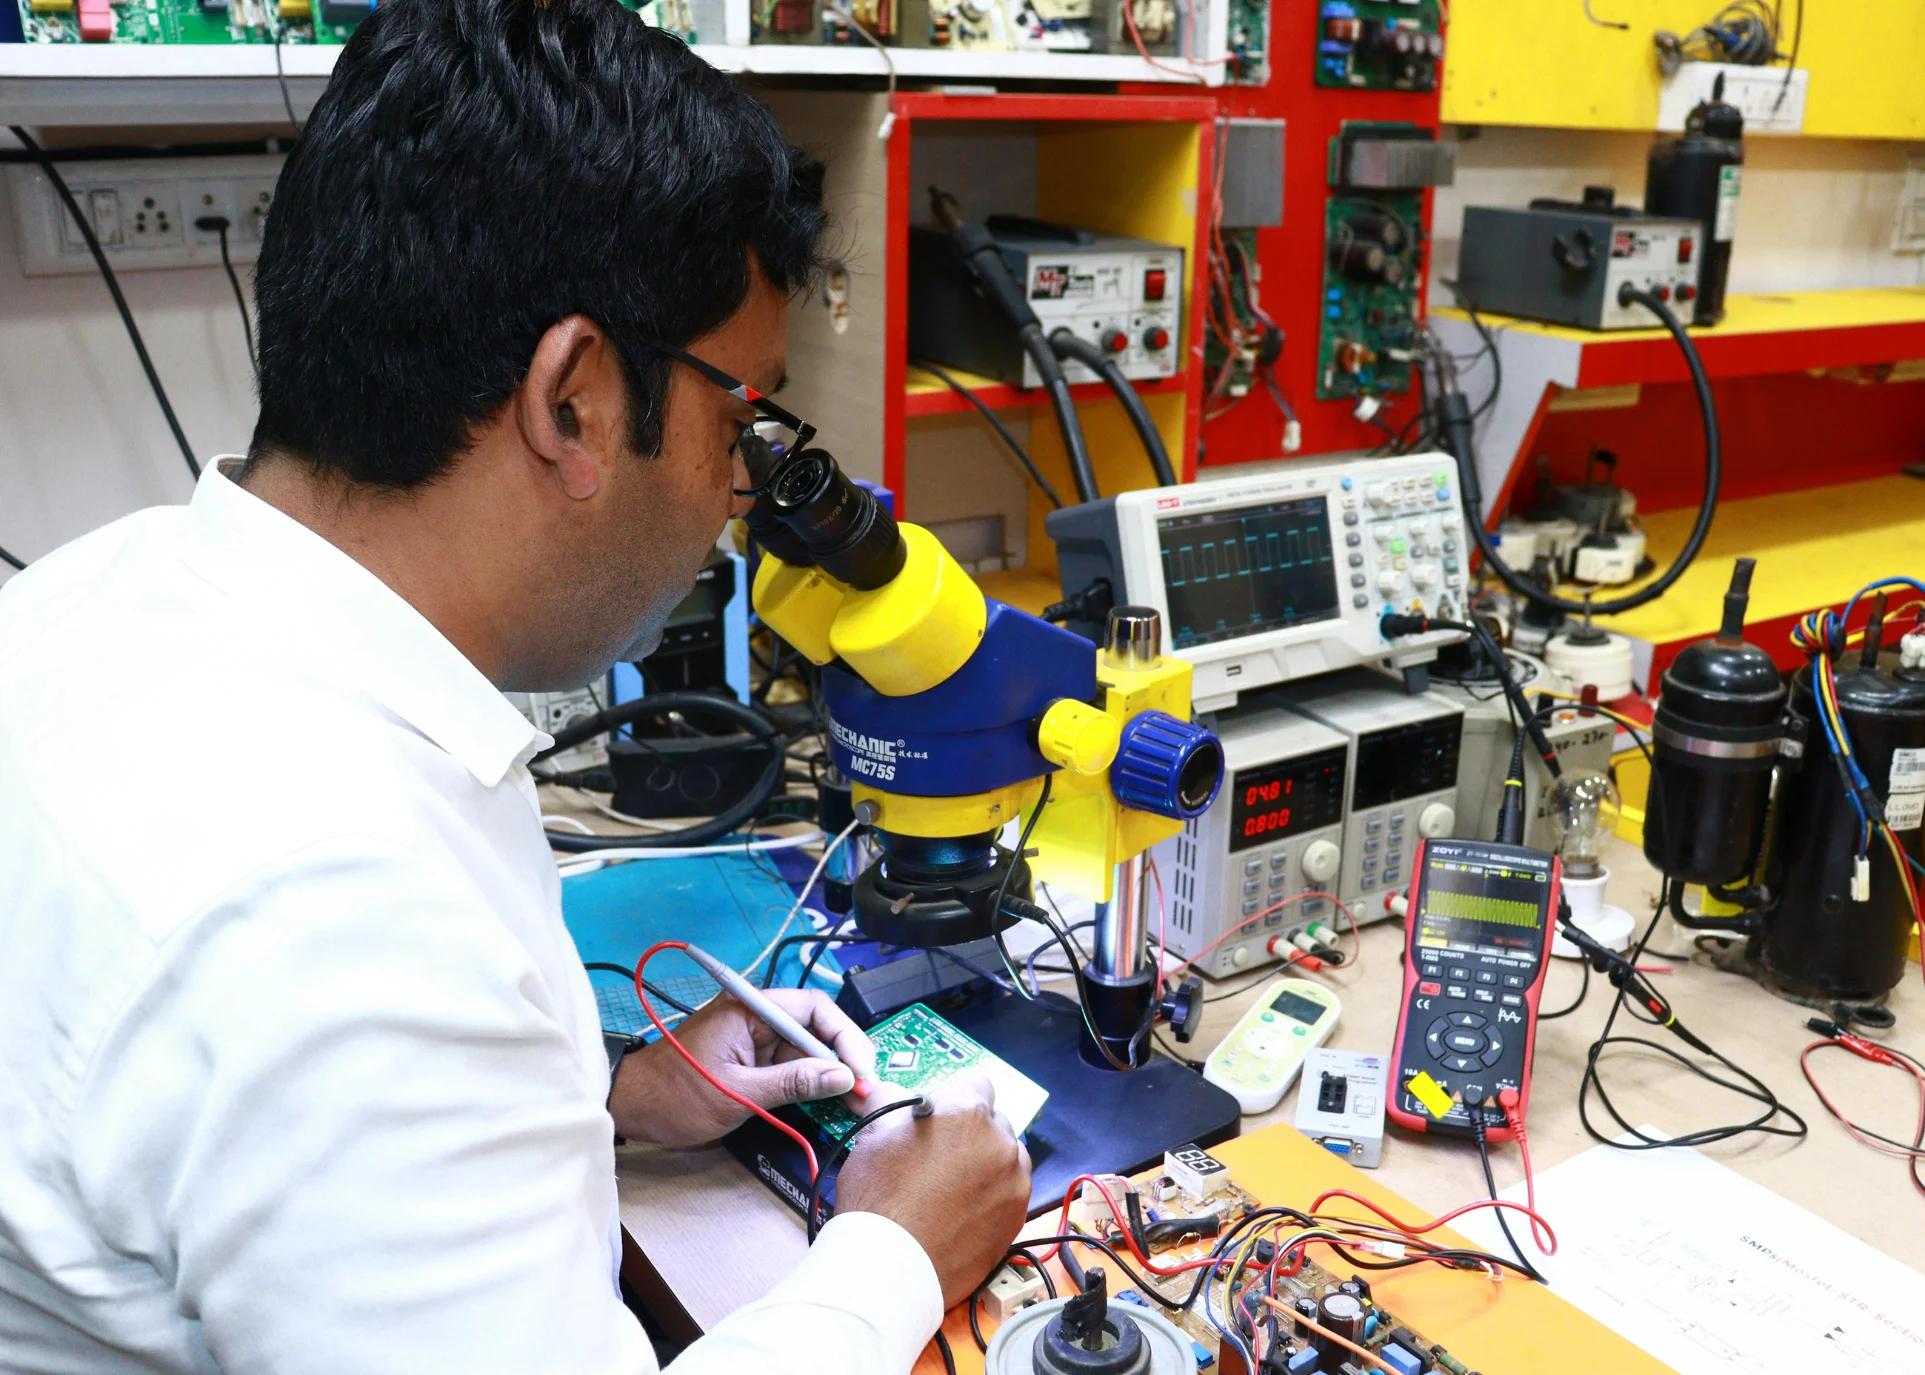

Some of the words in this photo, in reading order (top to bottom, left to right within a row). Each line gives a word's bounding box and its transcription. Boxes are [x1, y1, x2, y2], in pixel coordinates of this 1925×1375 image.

[851, 754, 896, 781] MC75S
[1431, 846, 1459, 856] ZOYI
[1439, 950, 1465, 959] COUNTS
[1480, 956, 1497, 964] AUTO
[1498, 958, 1519, 967] POWER
[1427, 965, 1437, 974] F1
[1454, 969, 1464, 977] F2
[1482, 972, 1491, 980] F3
[1509, 977, 1519, 985] F4
[1454, 1036, 1475, 1046] MENU
